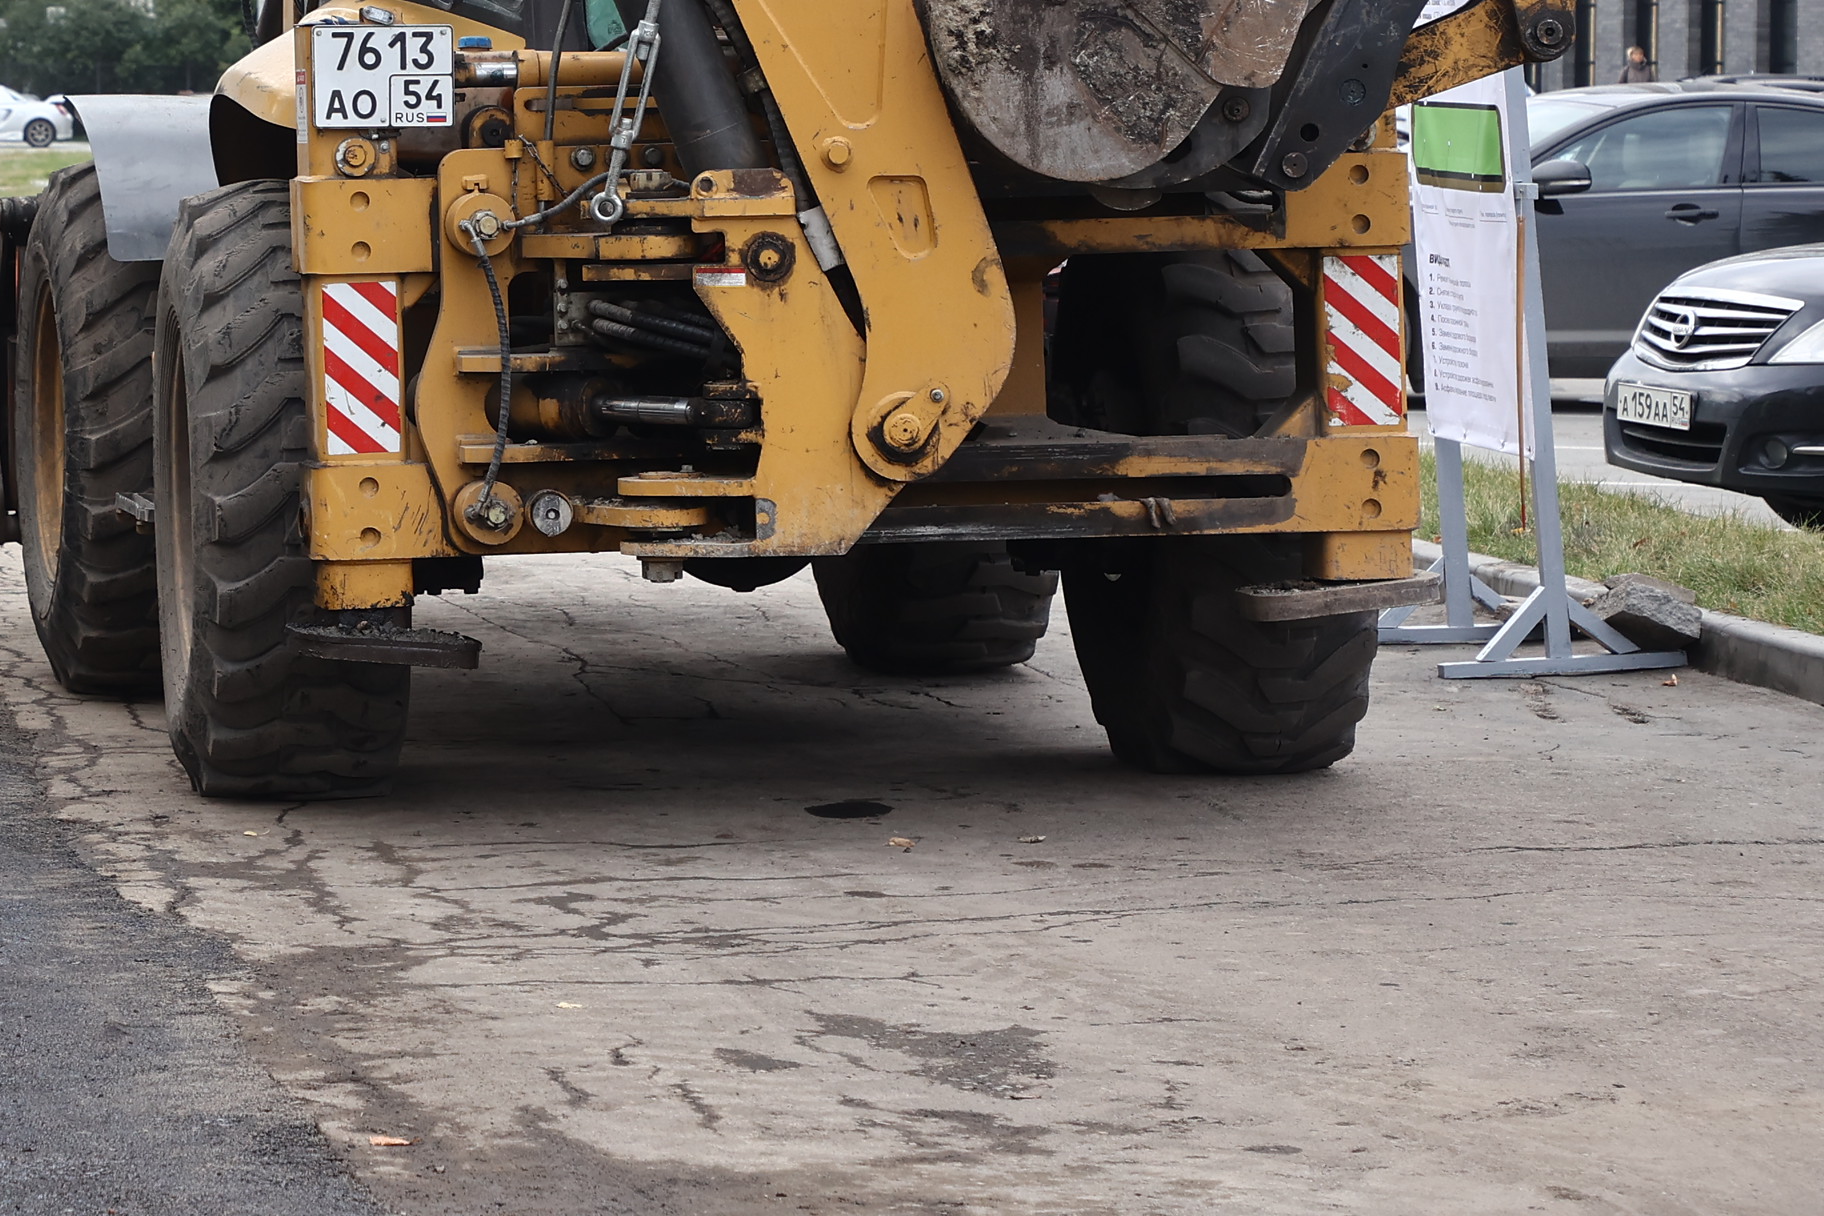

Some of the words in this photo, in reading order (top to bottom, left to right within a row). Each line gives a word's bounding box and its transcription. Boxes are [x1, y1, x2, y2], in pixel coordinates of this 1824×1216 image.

[331, 31, 435, 71] 7613
[325, 89, 377, 120] АО
[403, 79, 442, 109] 54
[395, 112, 425, 123] RUS
[1672, 395, 1685, 417] 54
